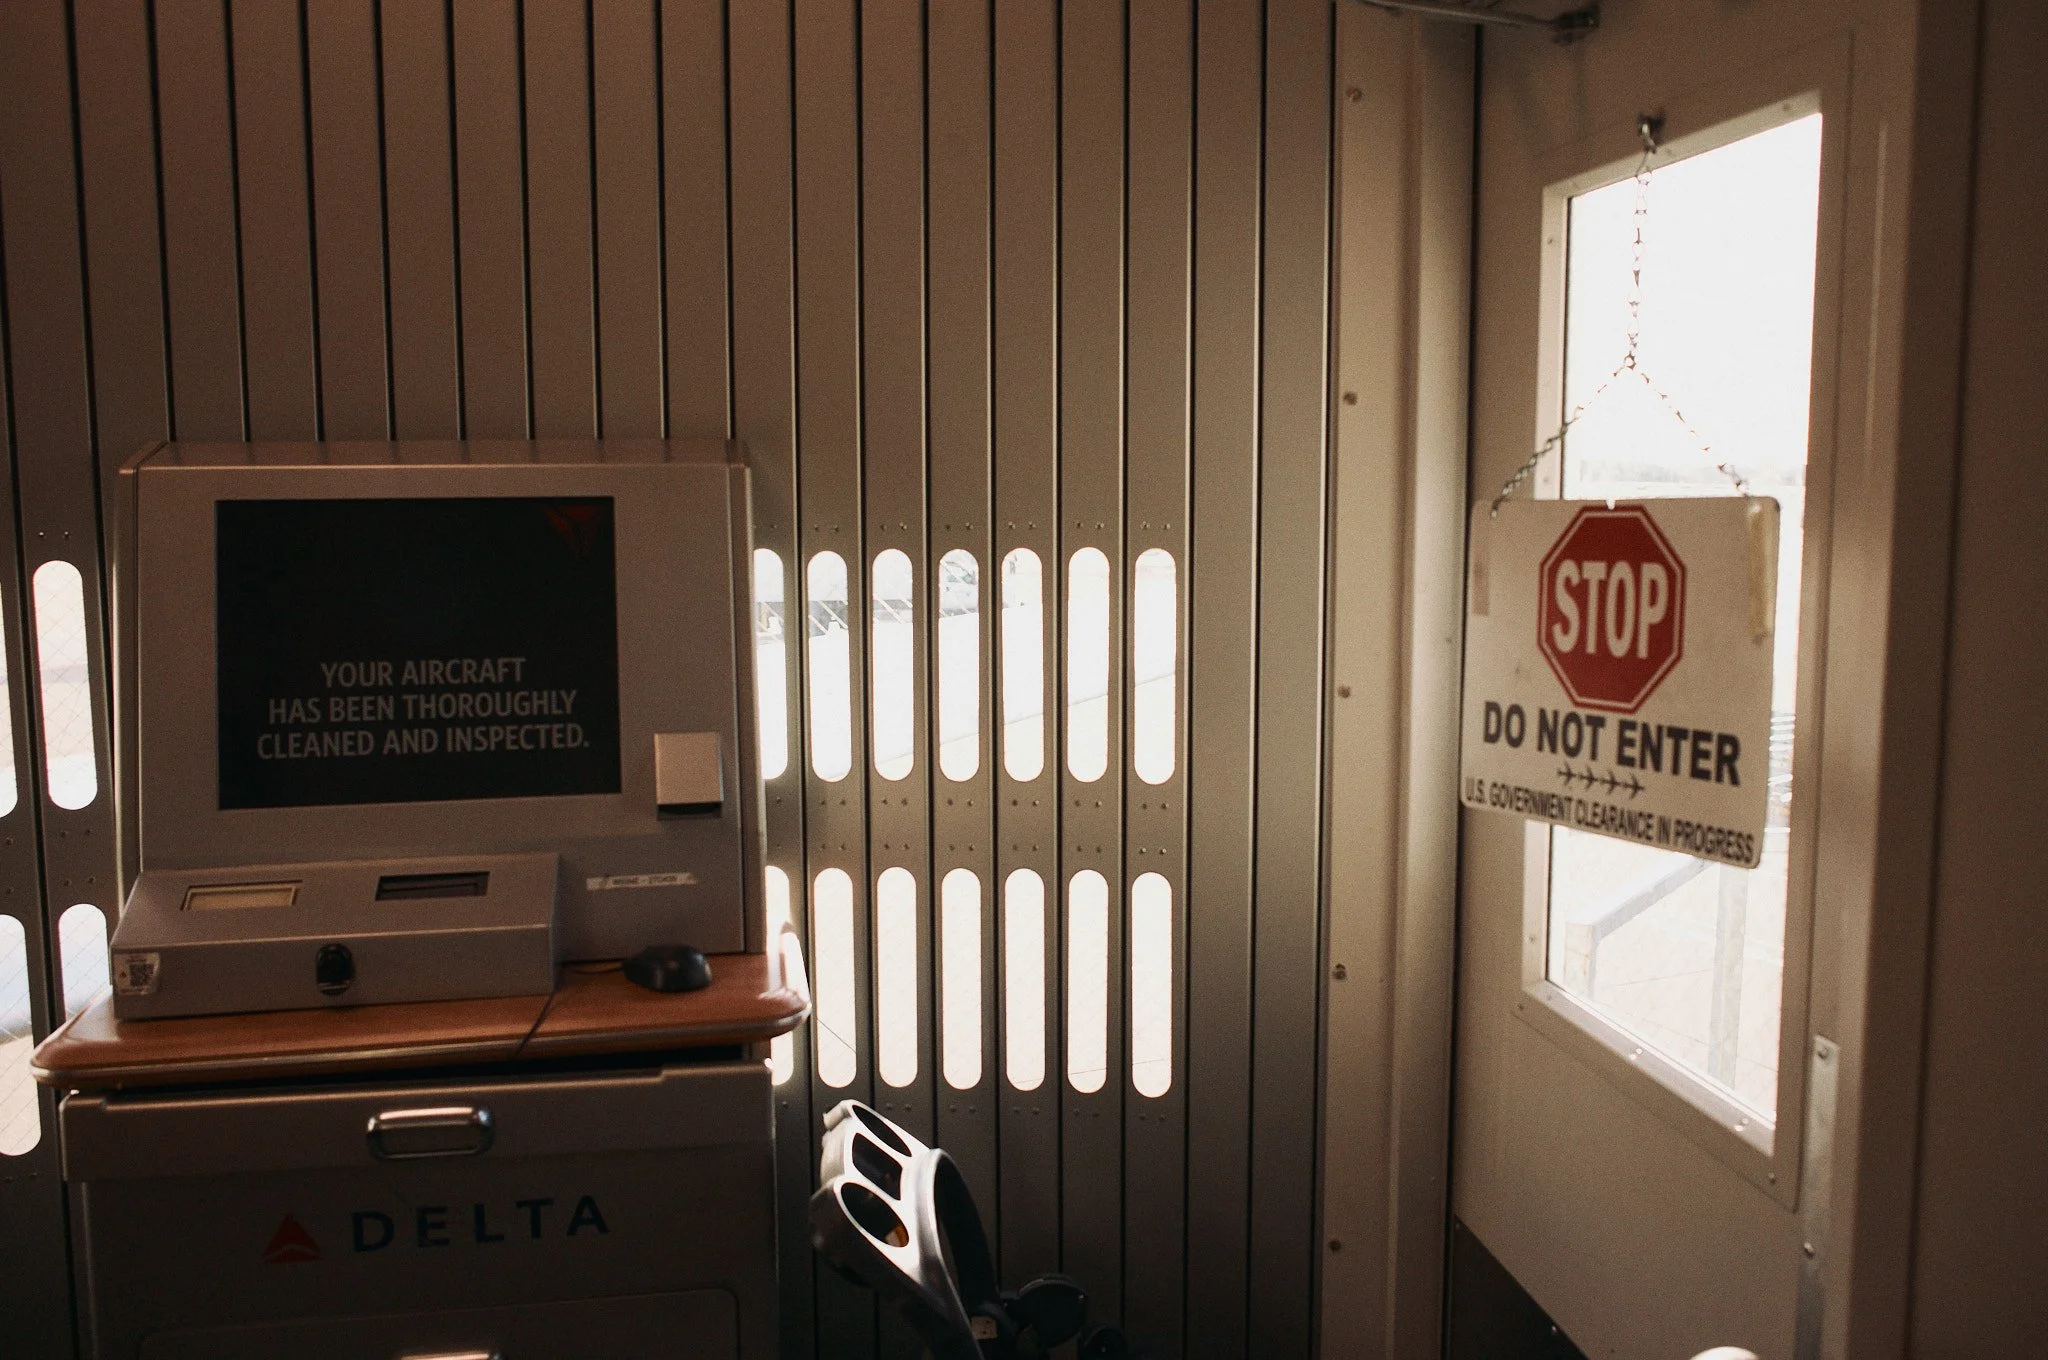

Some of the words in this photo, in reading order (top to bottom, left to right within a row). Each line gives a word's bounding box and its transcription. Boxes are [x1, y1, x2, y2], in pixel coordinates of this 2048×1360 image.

[1551, 559, 1669, 660] STOP
[320, 661, 393, 689] YOUR
[401, 656, 527, 686] AIRCRAFT
[269, 697, 322, 724] HAS
[330, 694, 395, 723] BEEN
[402, 688, 577, 720] THOROUGHLY
[257, 731, 375, 760] CLEANED
[382, 728, 439, 756] AND
[445, 723, 591, 753] INSPECTED.
[1484, 701, 1526, 748] DO
[1538, 708, 1606, 761] NOT
[1617, 719, 1741, 786] ENTER
[1464, 777, 1486, 804] U.S.
[1489, 782, 1573, 822] GOVERNMENT
[1574, 799, 1655, 842] CLEARANCE
[1657, 815, 1672, 845] IN
[1672, 818, 1754, 863] PROGRESS
[353, 1195, 610, 1253] DELTA
